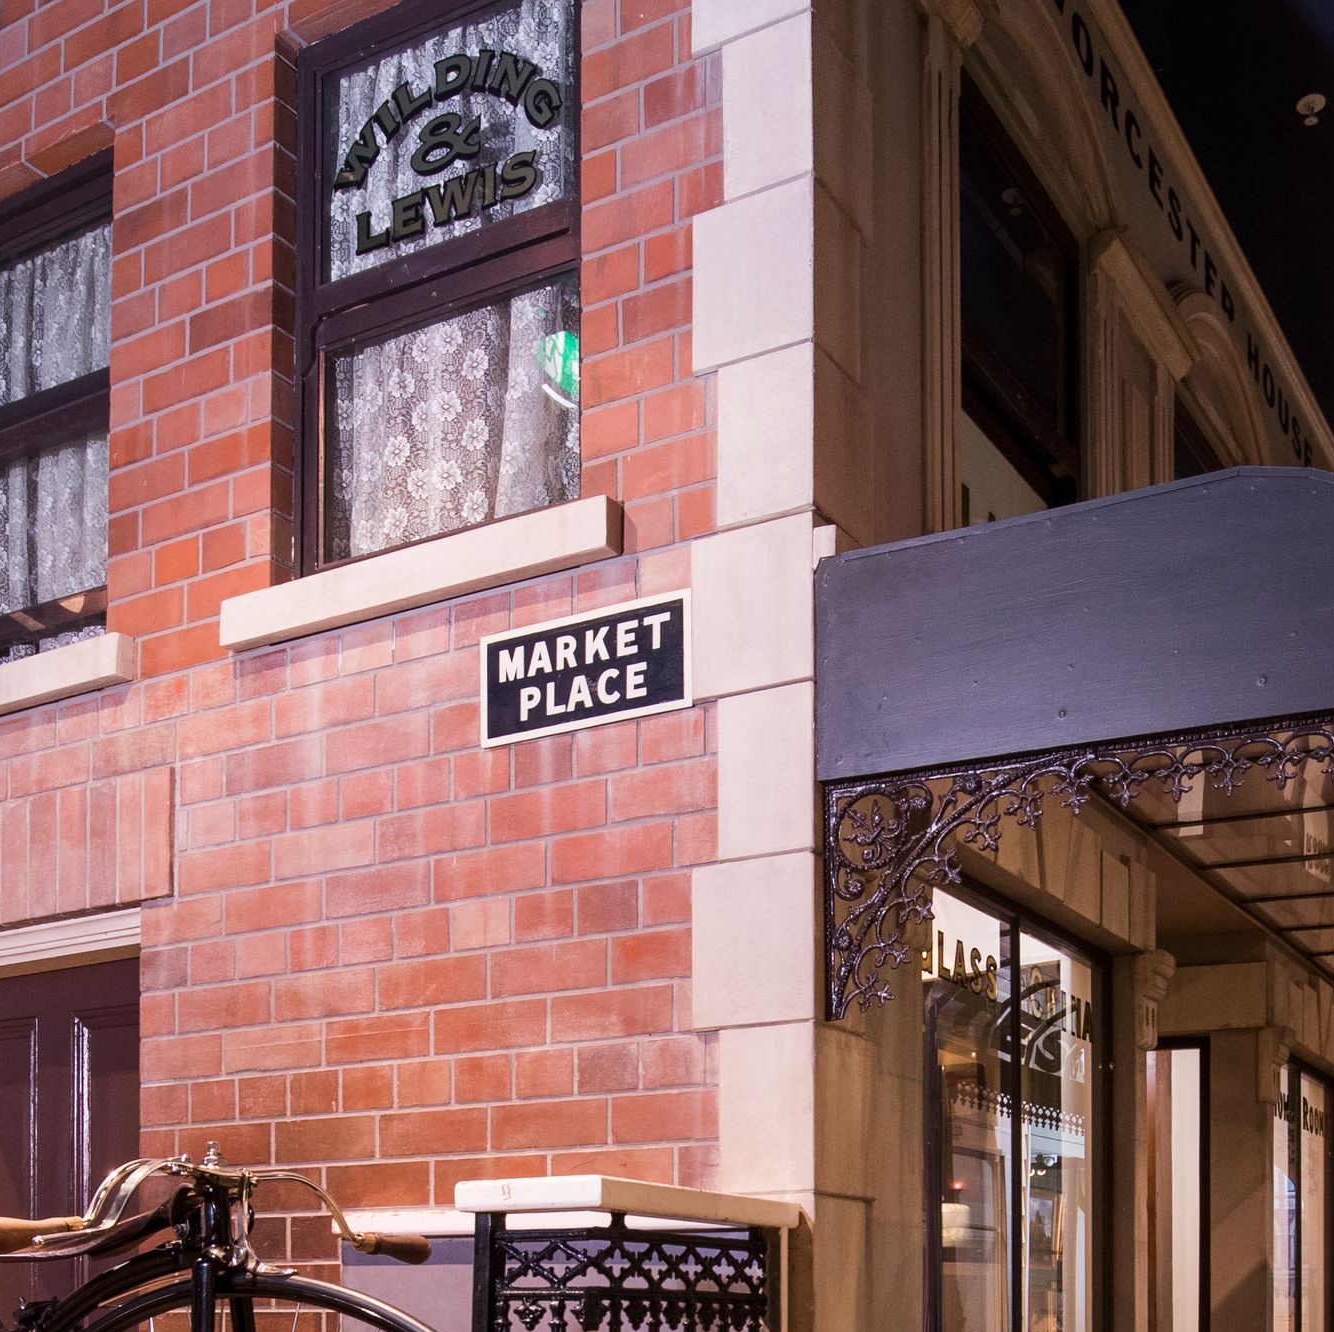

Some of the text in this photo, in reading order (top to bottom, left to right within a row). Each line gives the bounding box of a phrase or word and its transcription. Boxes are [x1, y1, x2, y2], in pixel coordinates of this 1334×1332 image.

[334, 50, 563, 191] WILDING
[410, 112, 482, 176] &
[1050, 0, 1235, 322] ORCESTER
[356, 150, 543, 255] LEWIS
[498, 611, 671, 683] MARKET
[519, 662, 650, 721] PLACE
